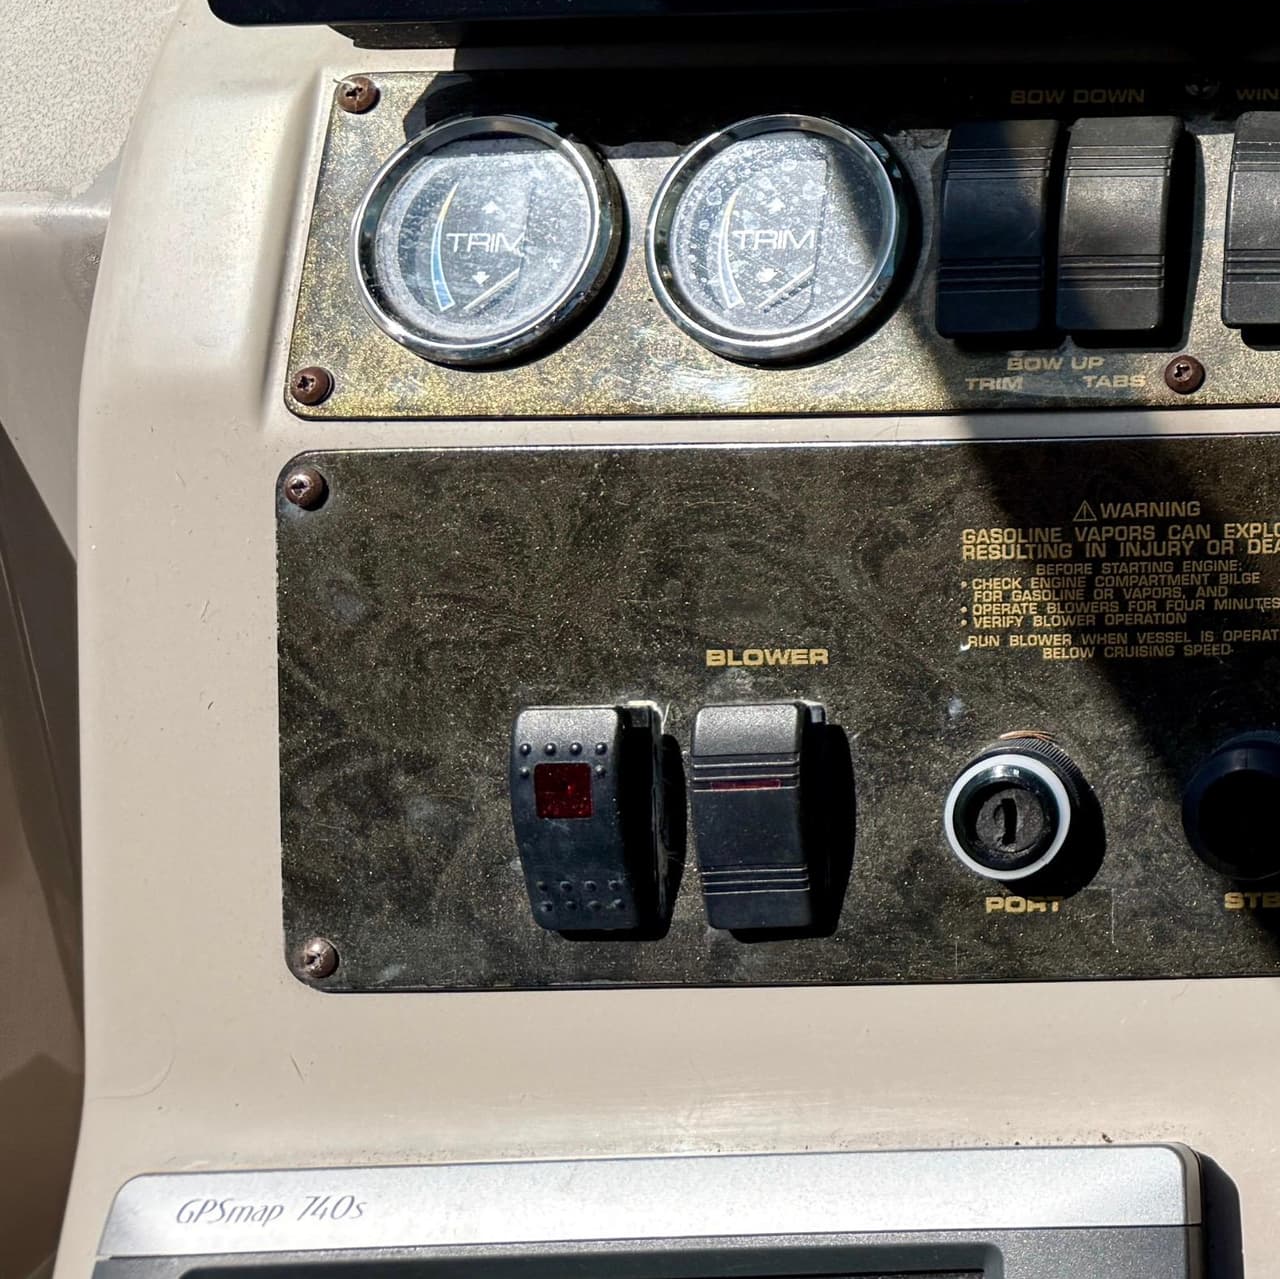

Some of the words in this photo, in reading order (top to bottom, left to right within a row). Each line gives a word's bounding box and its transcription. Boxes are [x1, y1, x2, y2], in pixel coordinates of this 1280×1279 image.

[1100, 502, 1200, 518] WARNING
[962, 528, 1061, 543] GASOLINE
[1075, 525, 1155, 542] VAPORS
[1168, 525, 1211, 539] CAN
[962, 544, 1072, 560] RESULTING
[1086, 543, 1105, 558] IN
[1120, 541, 1191, 558] INJURY
[1207, 540, 1234, 555] OR
[705, 649, 829, 666] BLOWER
[985, 896, 1061, 913] PORT
[175, 1197, 284, 1227] GPSmap
[297, 1195, 367, 1221] 740s
